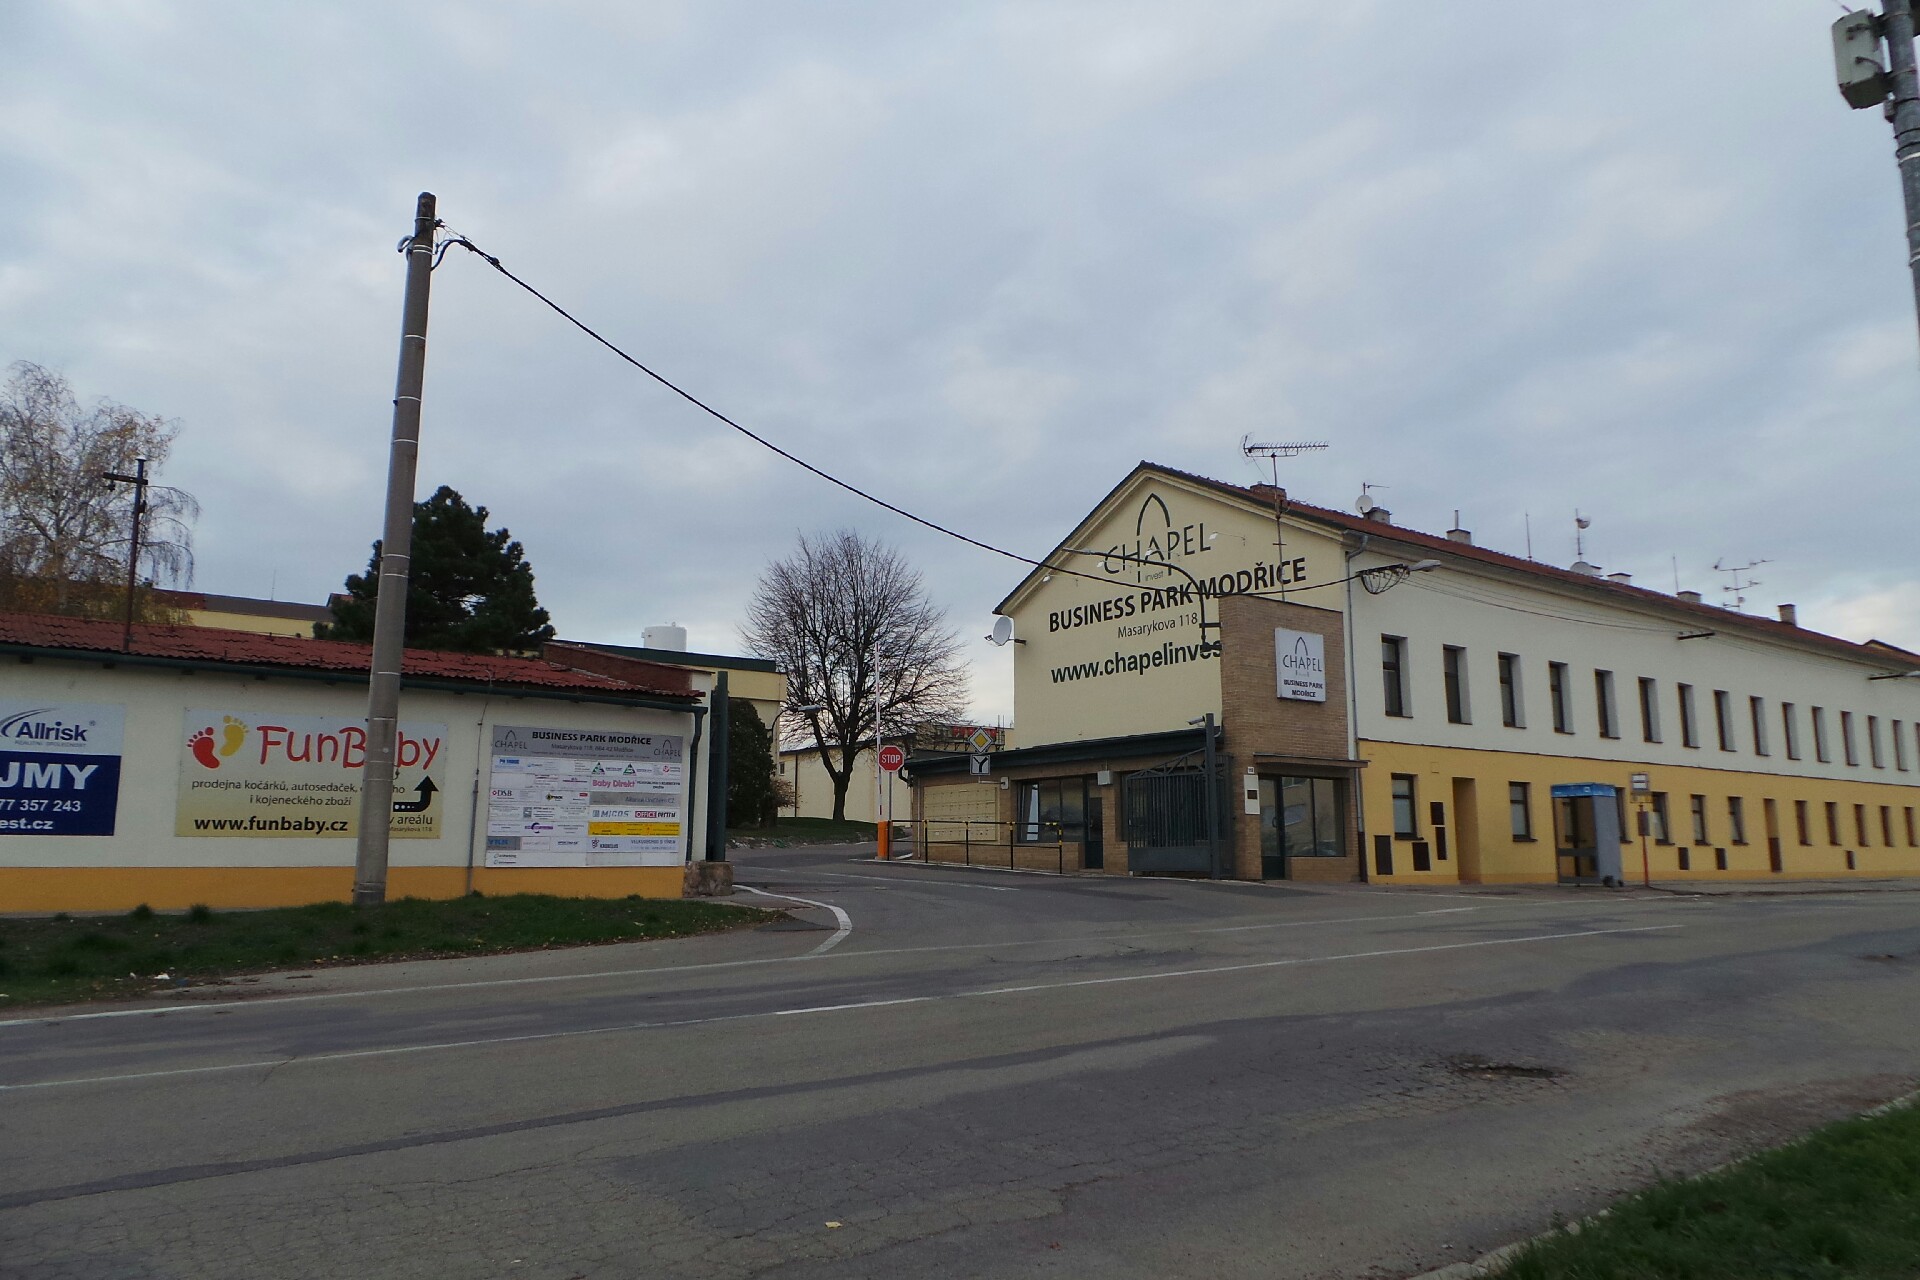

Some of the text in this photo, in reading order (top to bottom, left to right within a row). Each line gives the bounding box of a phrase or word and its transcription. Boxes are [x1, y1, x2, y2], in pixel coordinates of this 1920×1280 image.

[1104, 523, 1211, 574] CHAPEL
[1145, 571, 1164, 582] invest
[1050, 557, 1307, 632] BUSINESS PARK MODŘICE
[1117, 612, 1198, 638] Masarykova 118
[1282, 654, 1323, 672] CHAPEL
[1283, 679, 1323, 690] BUSINESS PARK
[16, 721, 87, 741] Allrisk
[532, 731, 652, 745] BUSINESS PARK MODŘICE
[257, 725, 440, 770] FunBby
[494, 740, 528, 750] CHAPEL
[653, 748, 681, 757] CHAPEL
[881, 754, 900, 763] STOP
[191, 779, 242, 790] prodejna
[244, 779, 289, 791] kočárků,
[291, 781, 358, 793] autosedaček,
[592, 779, 611, 788] Baby
[613, 780, 635, 788] Direkt
[20, 799, 49, 812] 357
[53, 800, 82, 812] 243
[249, 795, 352, 807] i kojeneckého zboží
[397, 814, 433, 825] areálu
[601, 810, 630, 818] MICOS
[0, 817, 54, 830] est.cz
[194, 816, 348, 834] www.funbaby.cz
